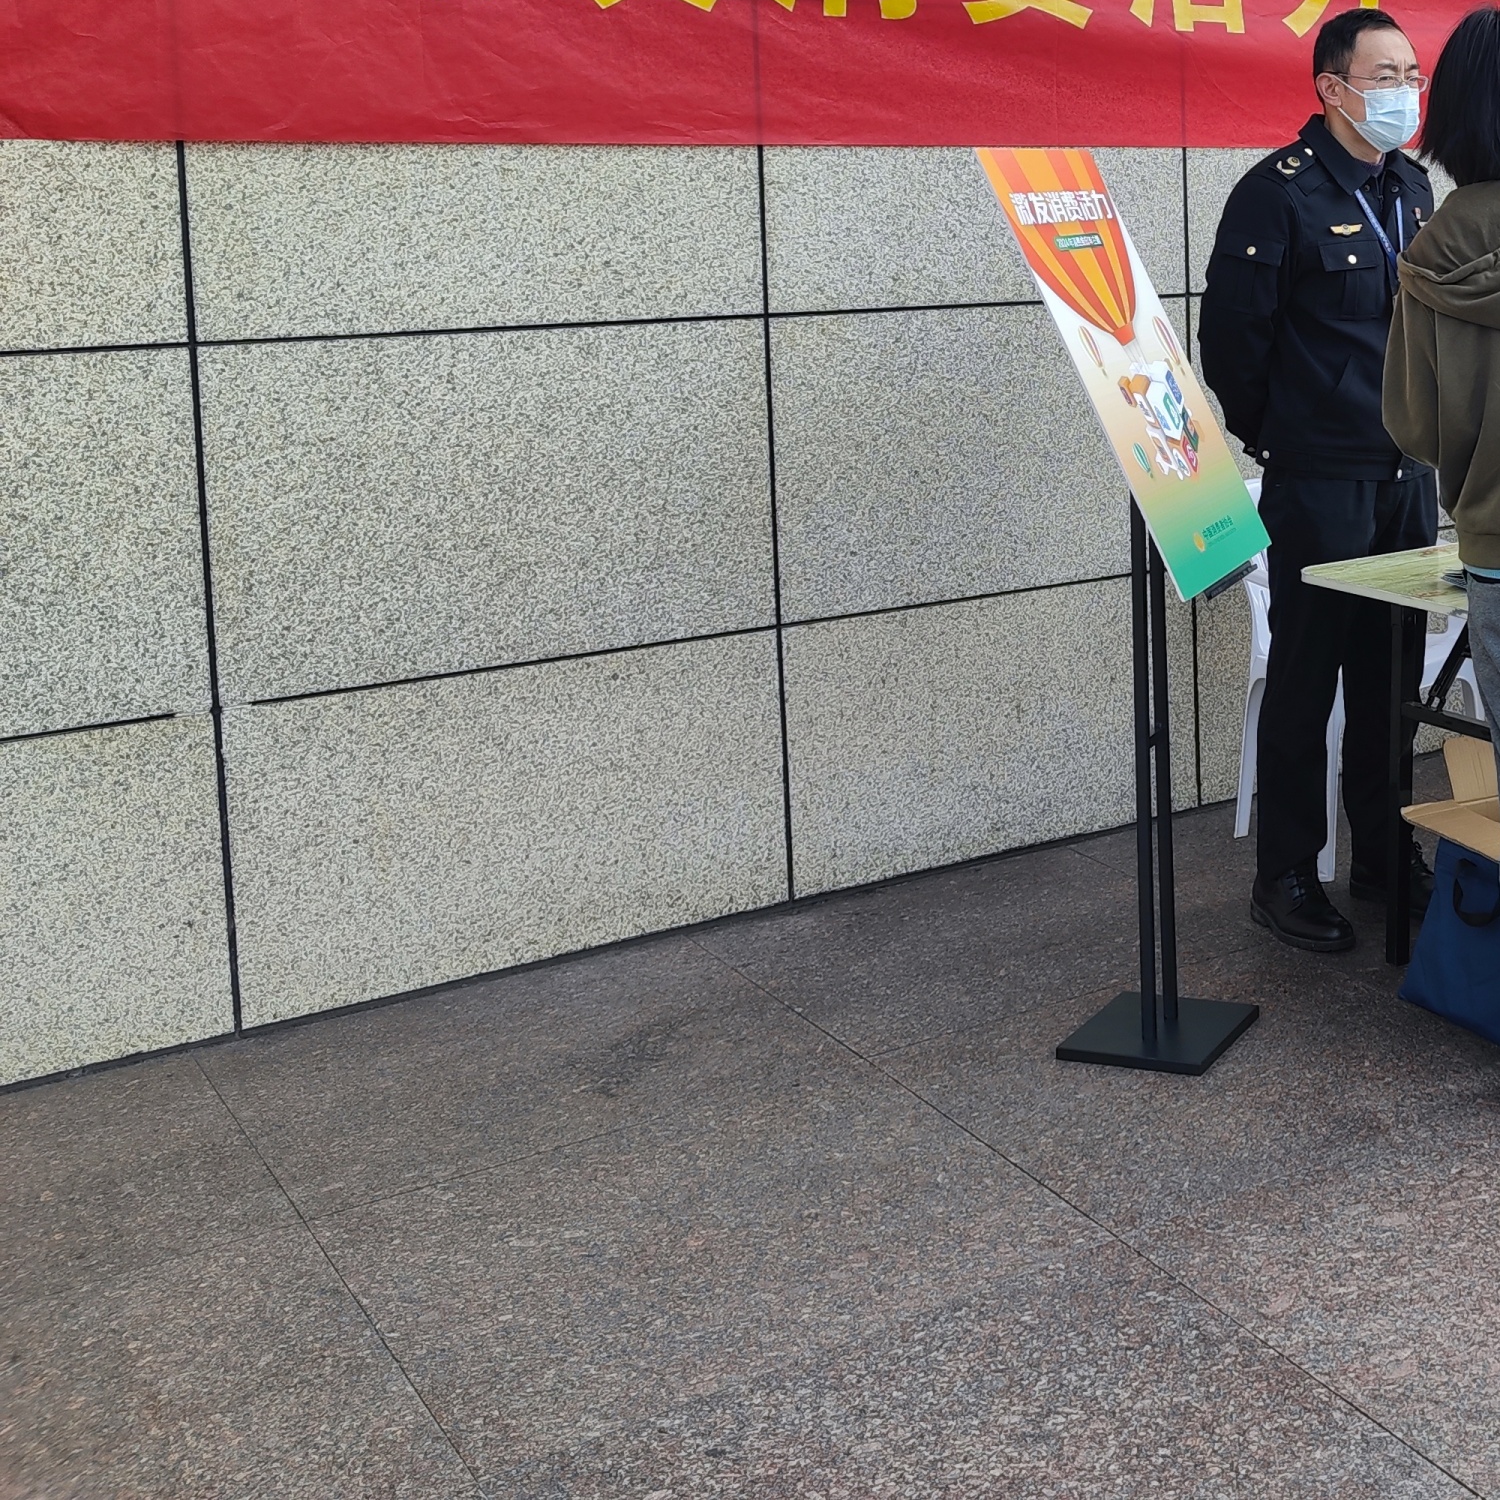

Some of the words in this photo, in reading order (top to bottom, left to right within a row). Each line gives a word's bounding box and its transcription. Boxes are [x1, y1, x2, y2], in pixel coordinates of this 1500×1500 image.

[1009, 190, 1113, 226] 激发消费活力
